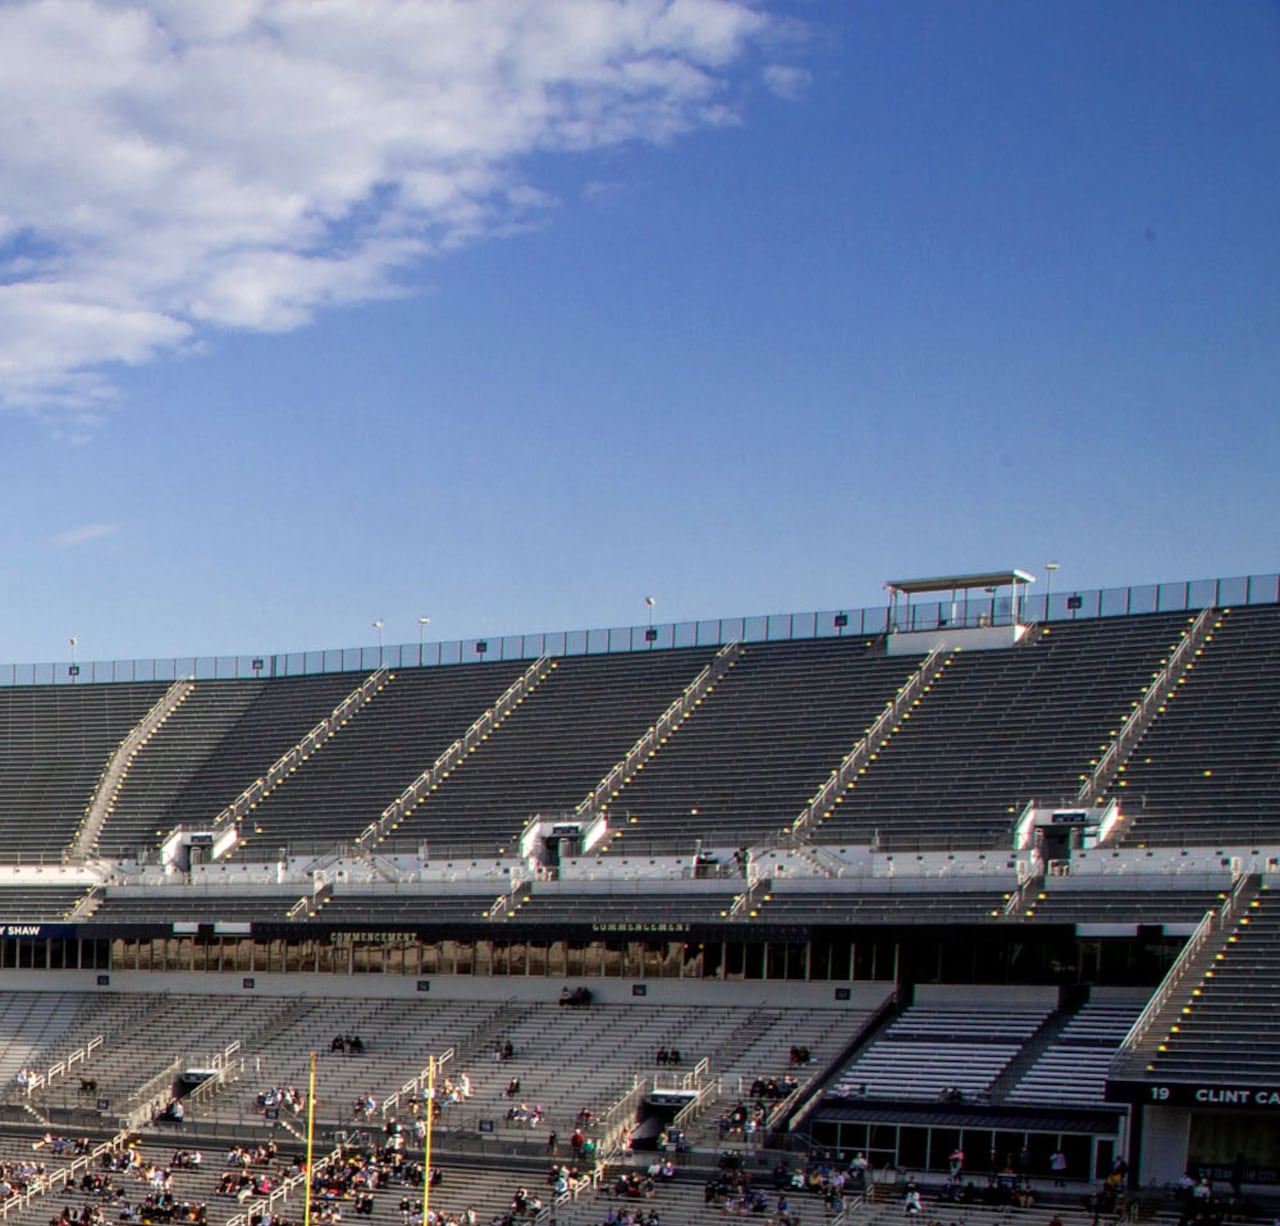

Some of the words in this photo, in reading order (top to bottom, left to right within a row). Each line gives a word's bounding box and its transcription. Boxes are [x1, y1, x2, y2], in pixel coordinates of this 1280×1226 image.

[7, 926, 40, 936] SHAW
[329, 931, 417, 942] COMMENCEMENT
[1151, 1087, 1170, 1100] 19
[1196, 1089, 1250, 1103] CLINT
